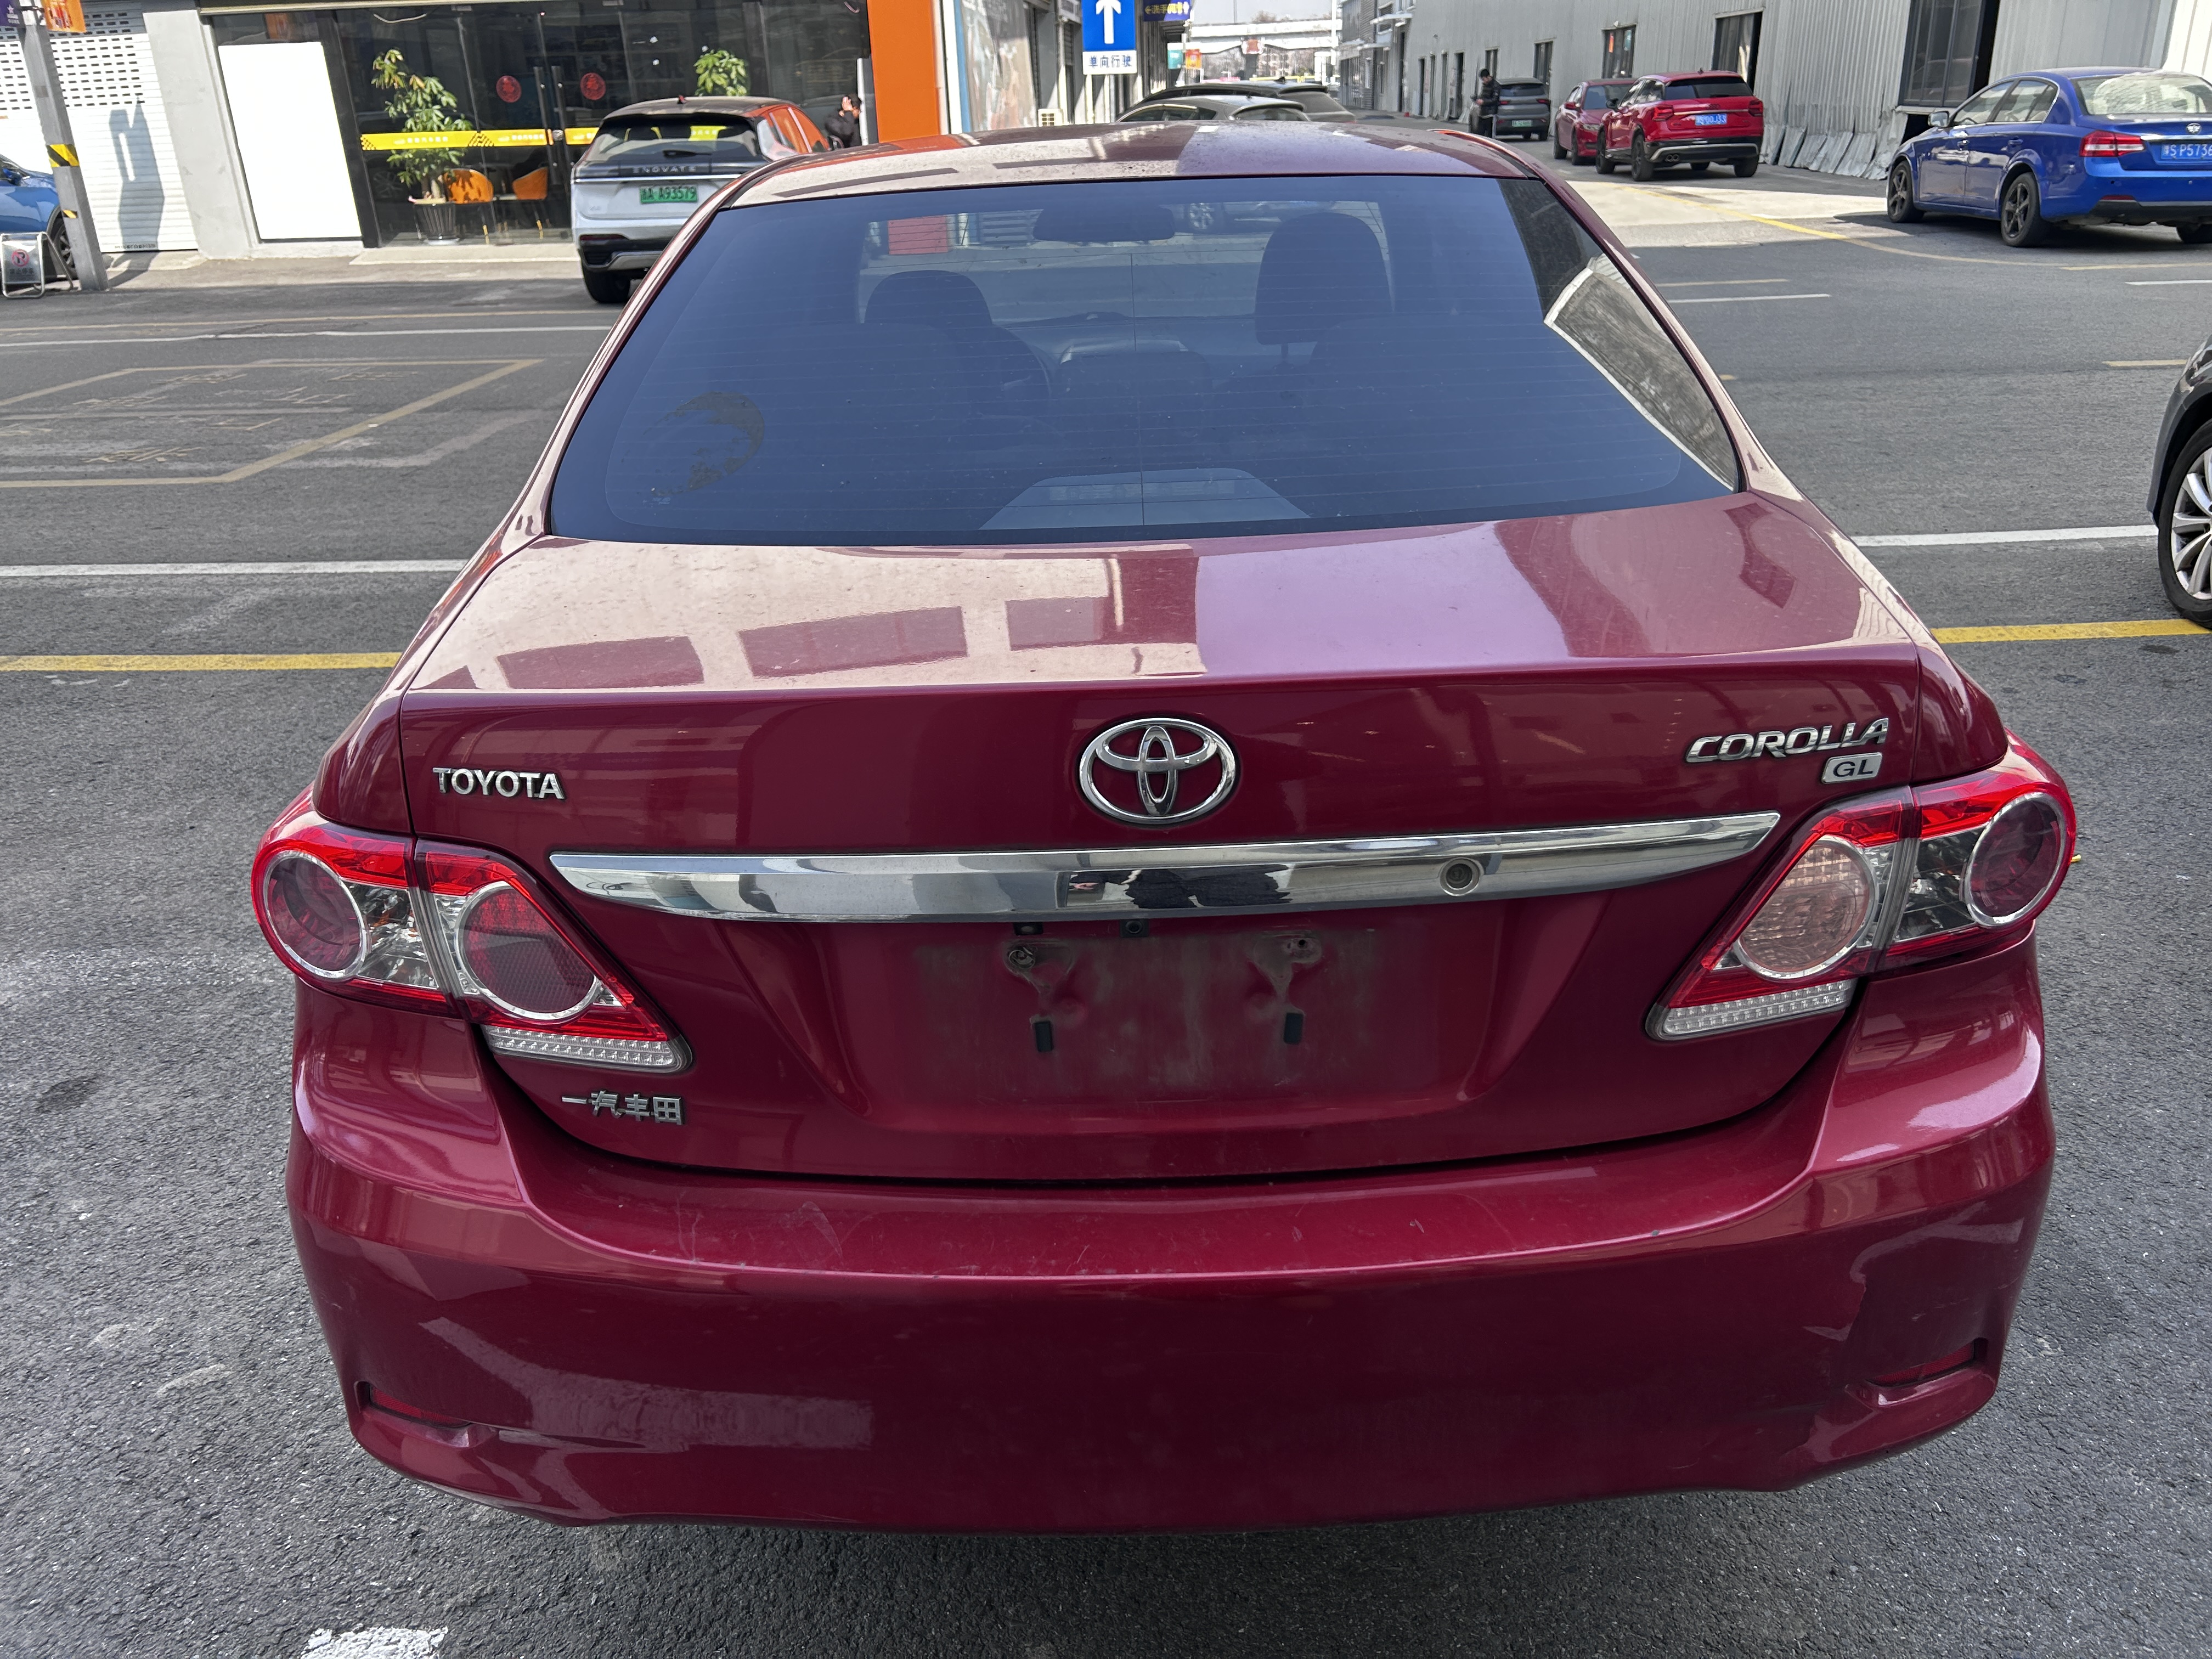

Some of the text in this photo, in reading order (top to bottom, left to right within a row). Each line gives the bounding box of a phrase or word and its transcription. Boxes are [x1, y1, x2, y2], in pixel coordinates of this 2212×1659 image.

[1088, 55, 1132, 68] 单向行驶
[2163, 144, 2212, 156] SP5736
[1685, 717, 1889, 764] COROLLA
[1832, 759, 1874, 778] GL
[432, 767, 566, 800] TOYOTA
[561, 1090, 684, 1125] 一汽丰田
